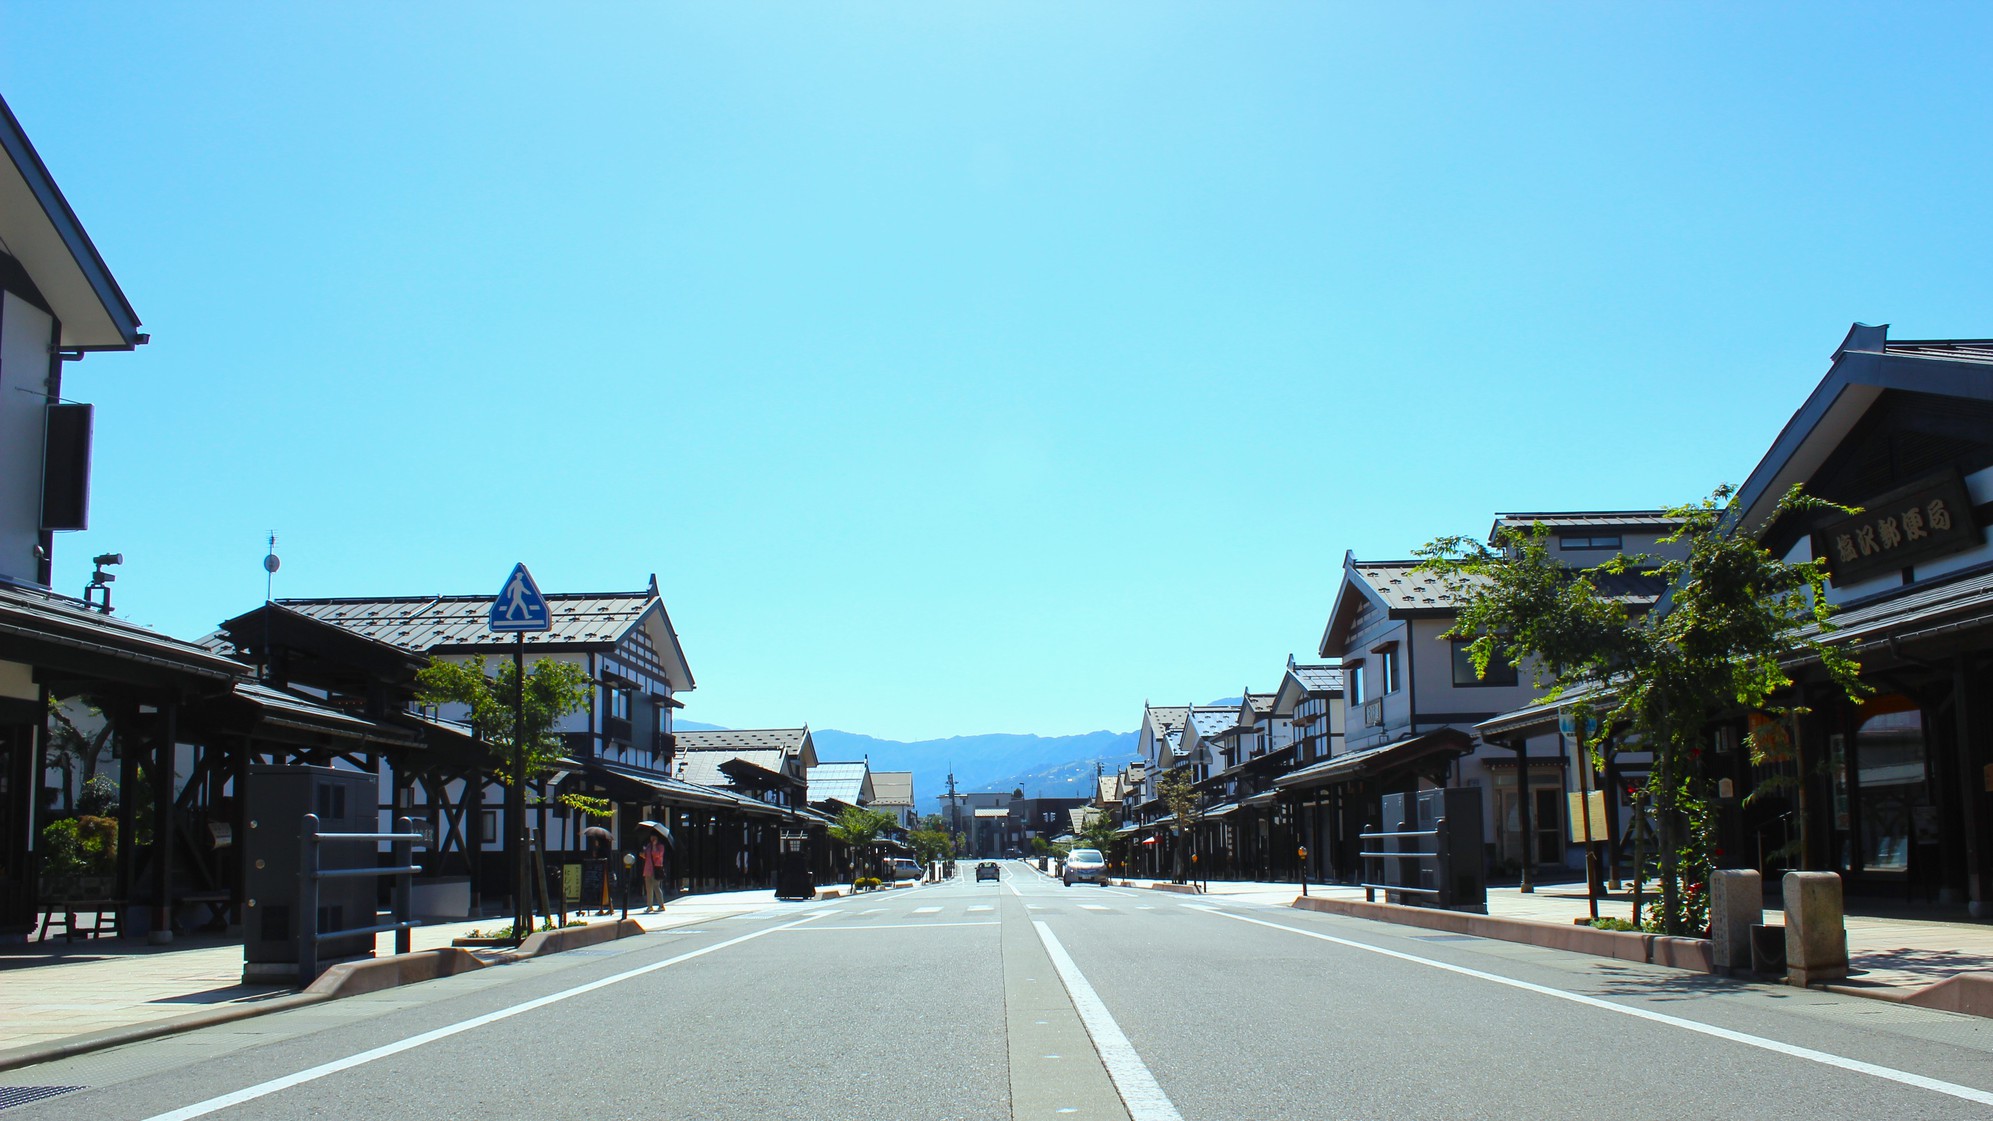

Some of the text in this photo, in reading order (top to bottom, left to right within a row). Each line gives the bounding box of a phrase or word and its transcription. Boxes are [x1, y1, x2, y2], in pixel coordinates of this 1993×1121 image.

[1837, 500, 1951, 562] 塩沢郵便局
